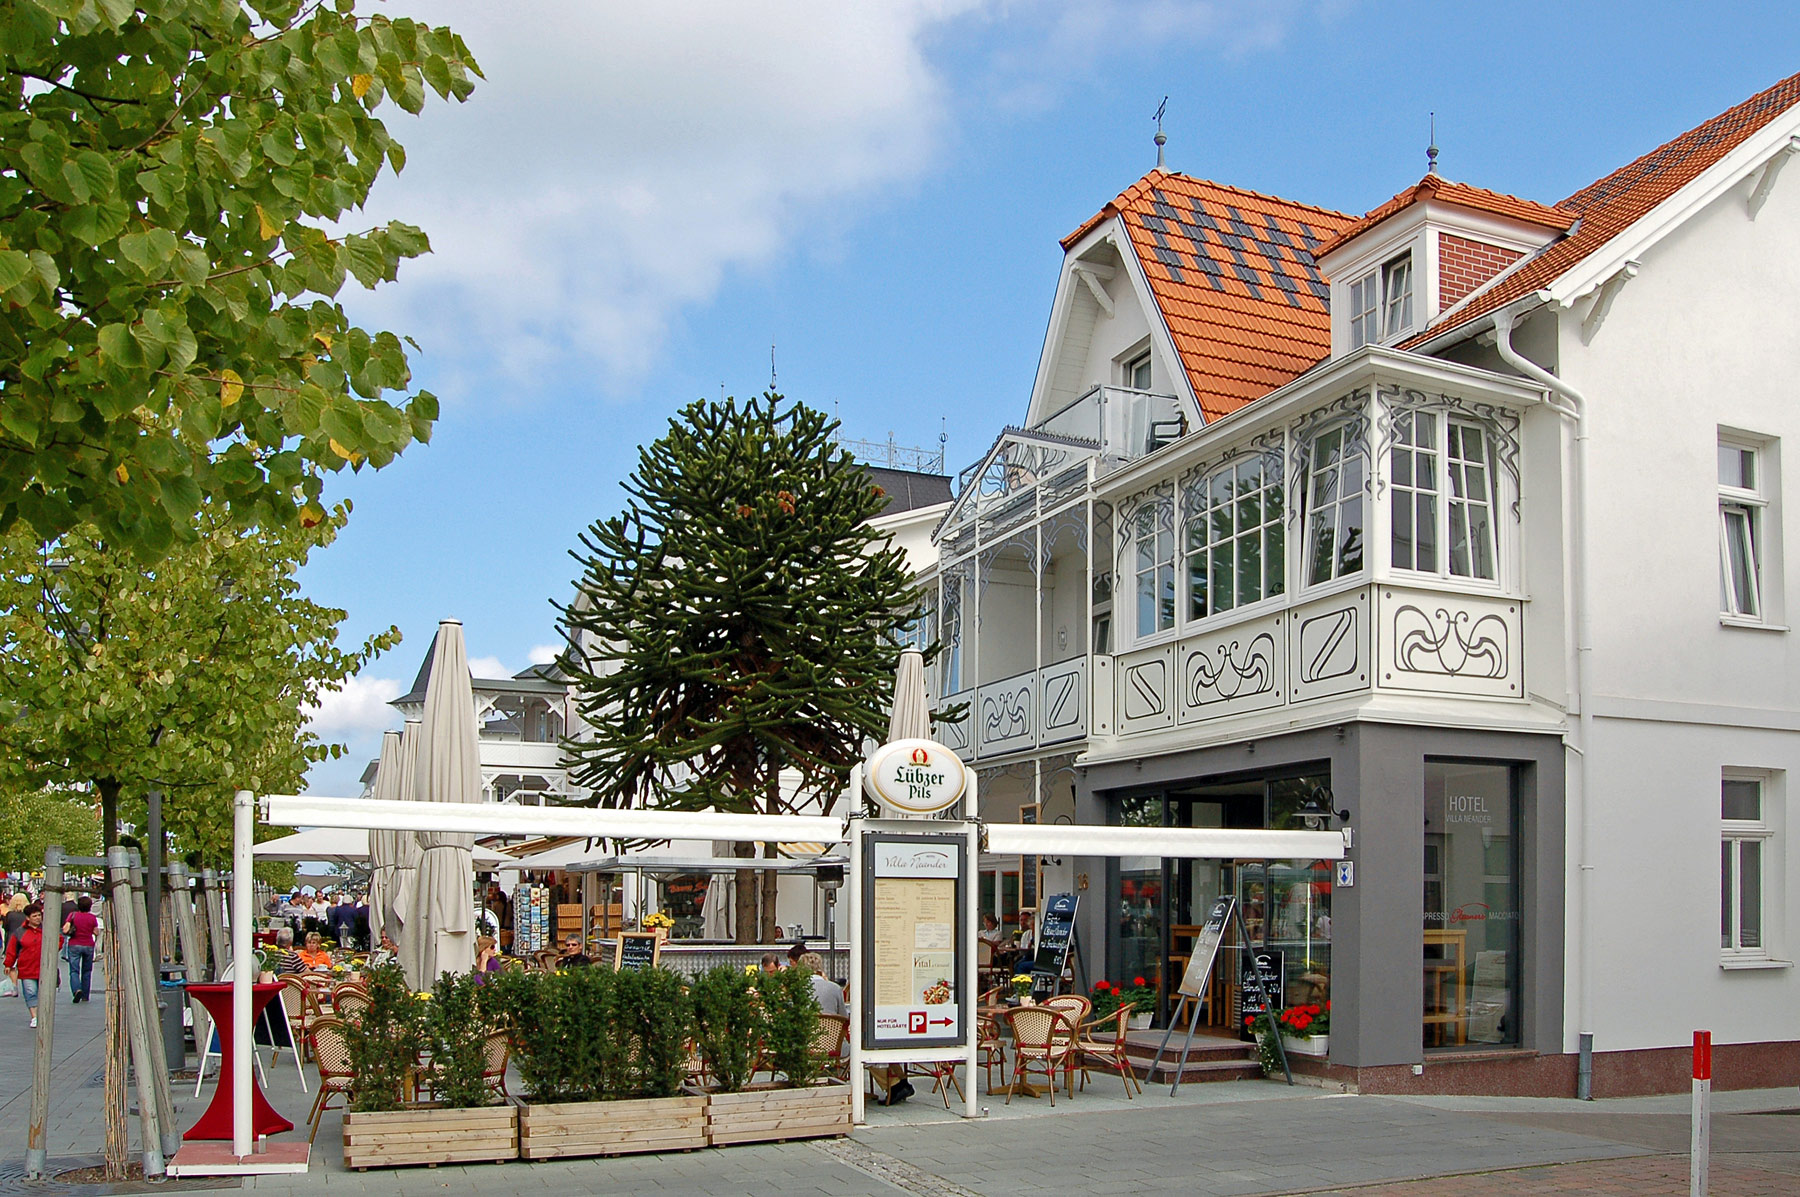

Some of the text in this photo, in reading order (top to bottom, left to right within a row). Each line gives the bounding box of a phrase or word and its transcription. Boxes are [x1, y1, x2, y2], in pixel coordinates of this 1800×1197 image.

[894, 766, 945, 787] Lübzer
[909, 784, 932, 800] Pils
[1449, 796, 1488, 812] HOTEL
[1446, 815, 1463, 823] VILLA
[885, 856, 908, 868] Villa
[1078, 872, 1088, 890] 16
[914, 954, 931, 968] Vital
[911, 1014, 925, 1032] P
